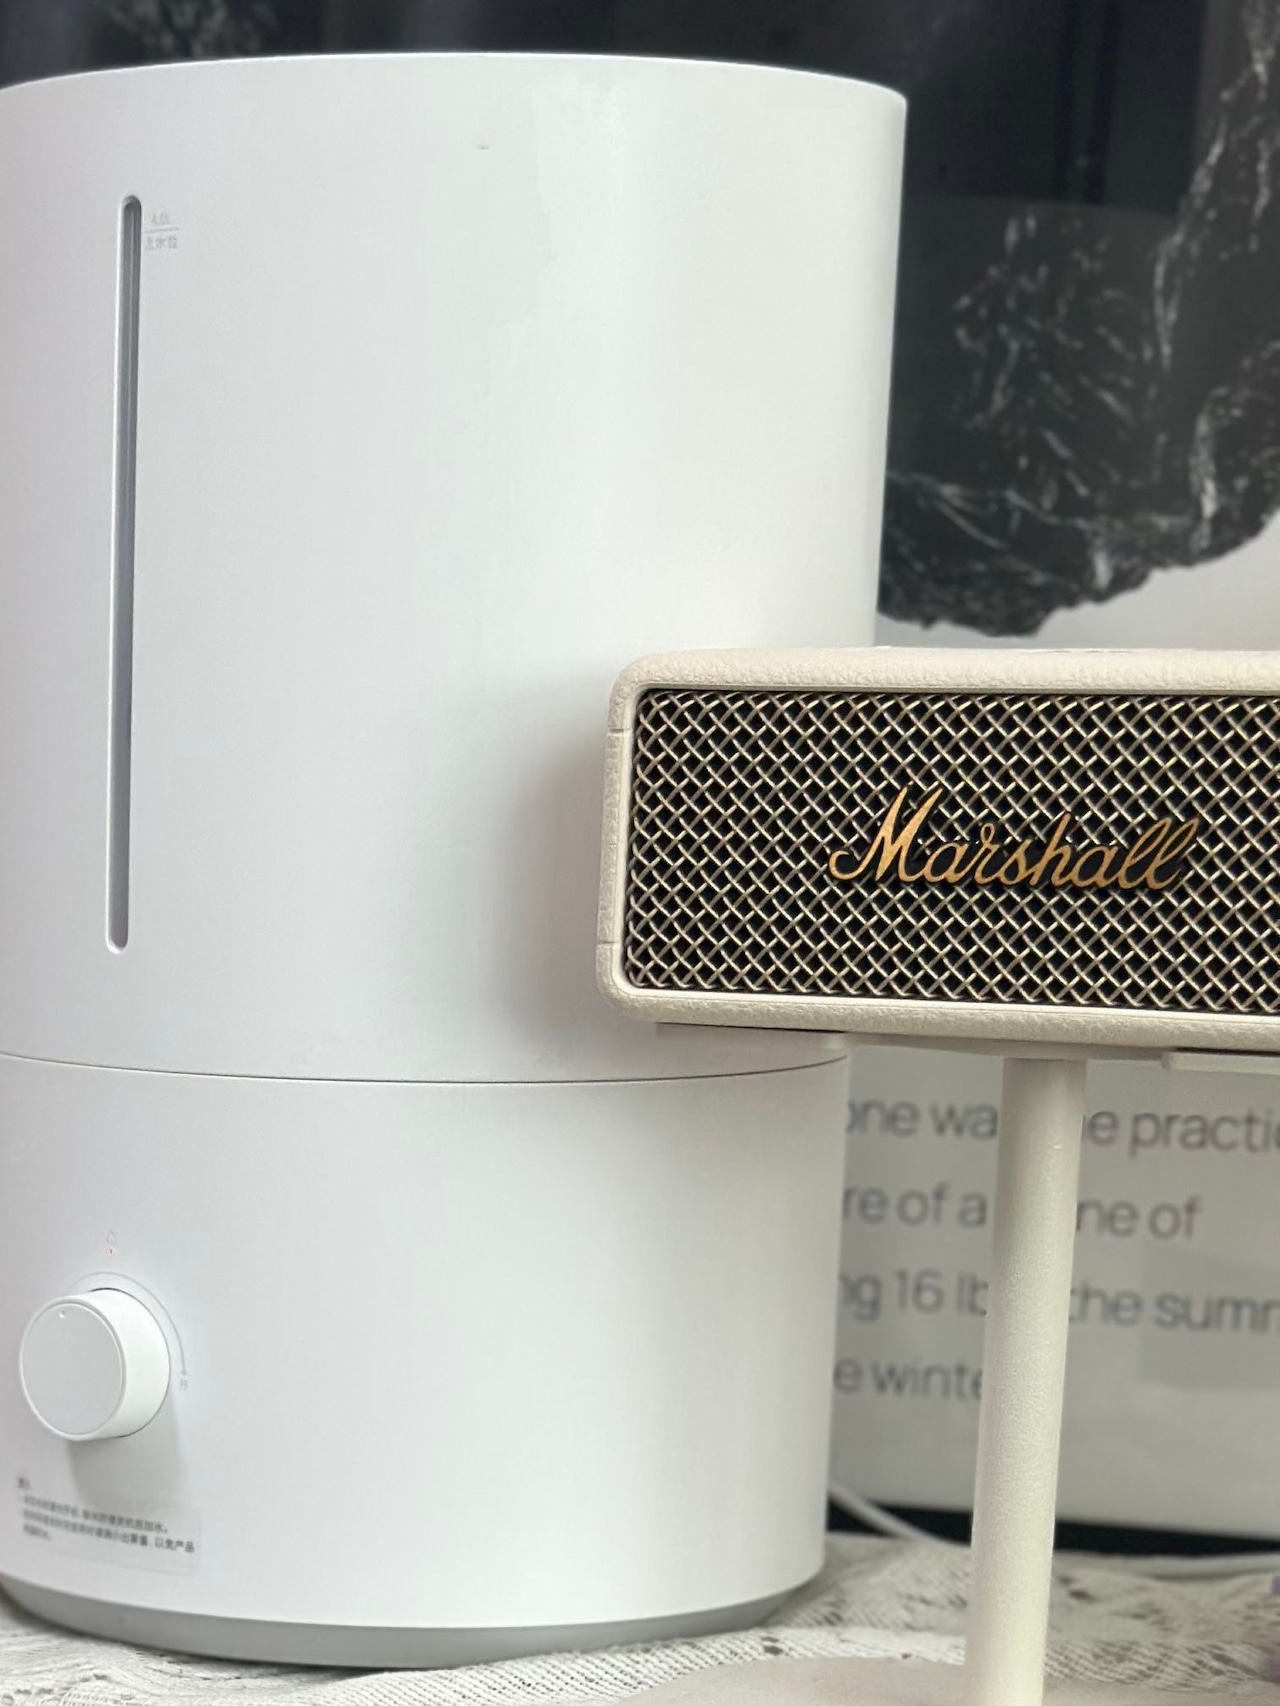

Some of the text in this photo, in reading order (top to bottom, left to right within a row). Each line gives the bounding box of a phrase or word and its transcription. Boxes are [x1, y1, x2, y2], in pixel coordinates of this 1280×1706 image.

[828, 785, 1200, 890] Marshall
[1129, 1109, 1280, 1158] practi
[896, 1181, 950, 1228] of
[1148, 1194, 1203, 1240] of
[892, 1267, 946, 1315] 16
